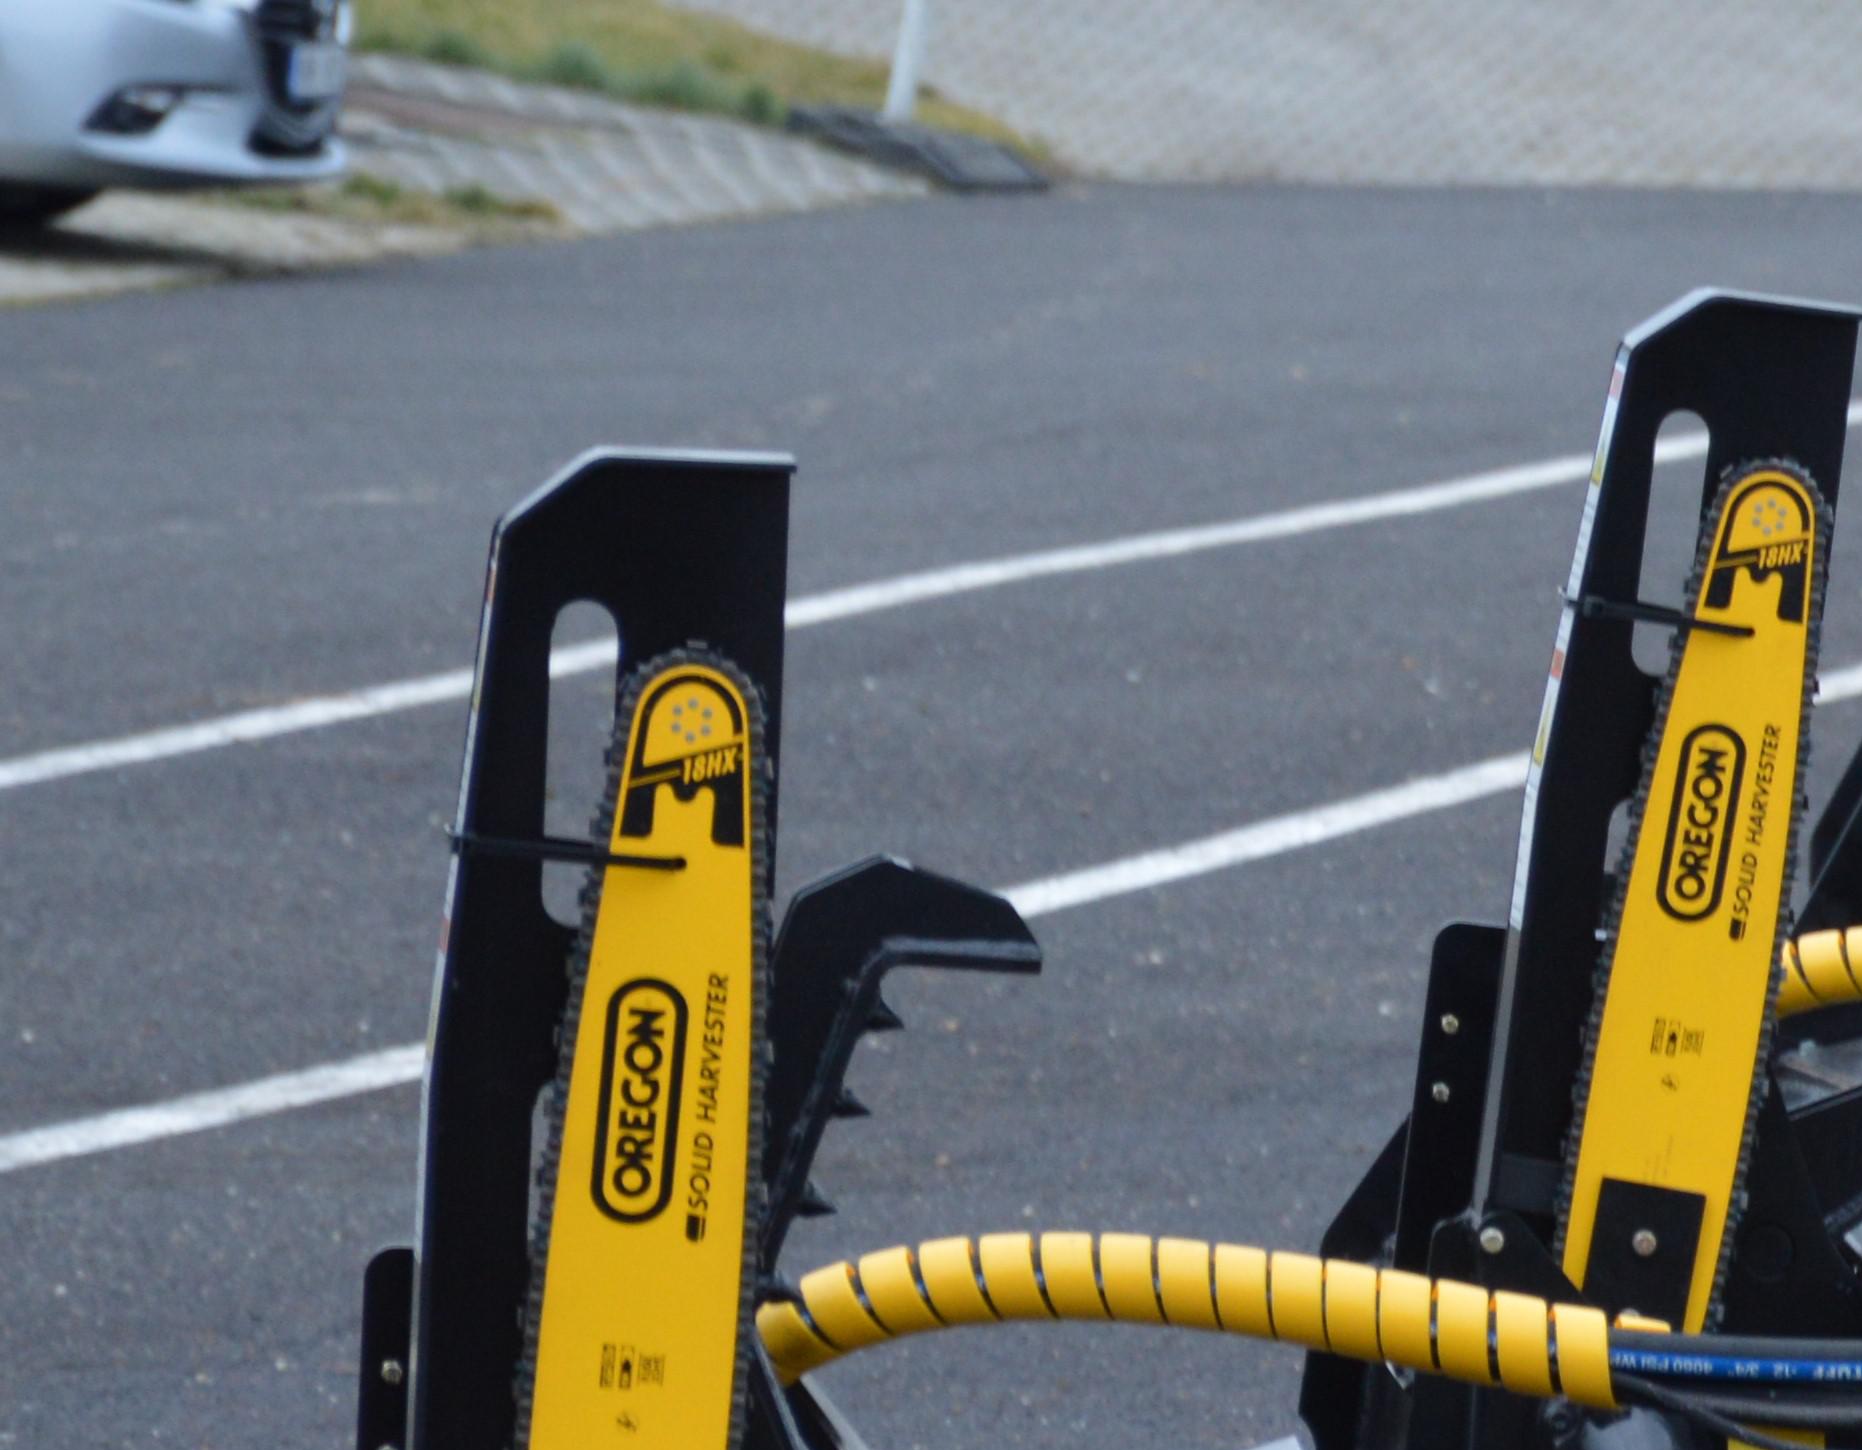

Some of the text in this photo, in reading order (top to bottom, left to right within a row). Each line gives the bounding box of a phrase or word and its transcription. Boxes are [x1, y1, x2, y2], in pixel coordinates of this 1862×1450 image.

[1759, 540, 1804, 570] 18HX
[683, 746, 737, 785] 18HX
[1674, 747, 1729, 902] OREGON
[1733, 723, 1781, 917] SOLID HARVESTER
[612, 1007, 667, 1198] OREGON
[688, 972, 728, 1213] SOLID HARVESTER
